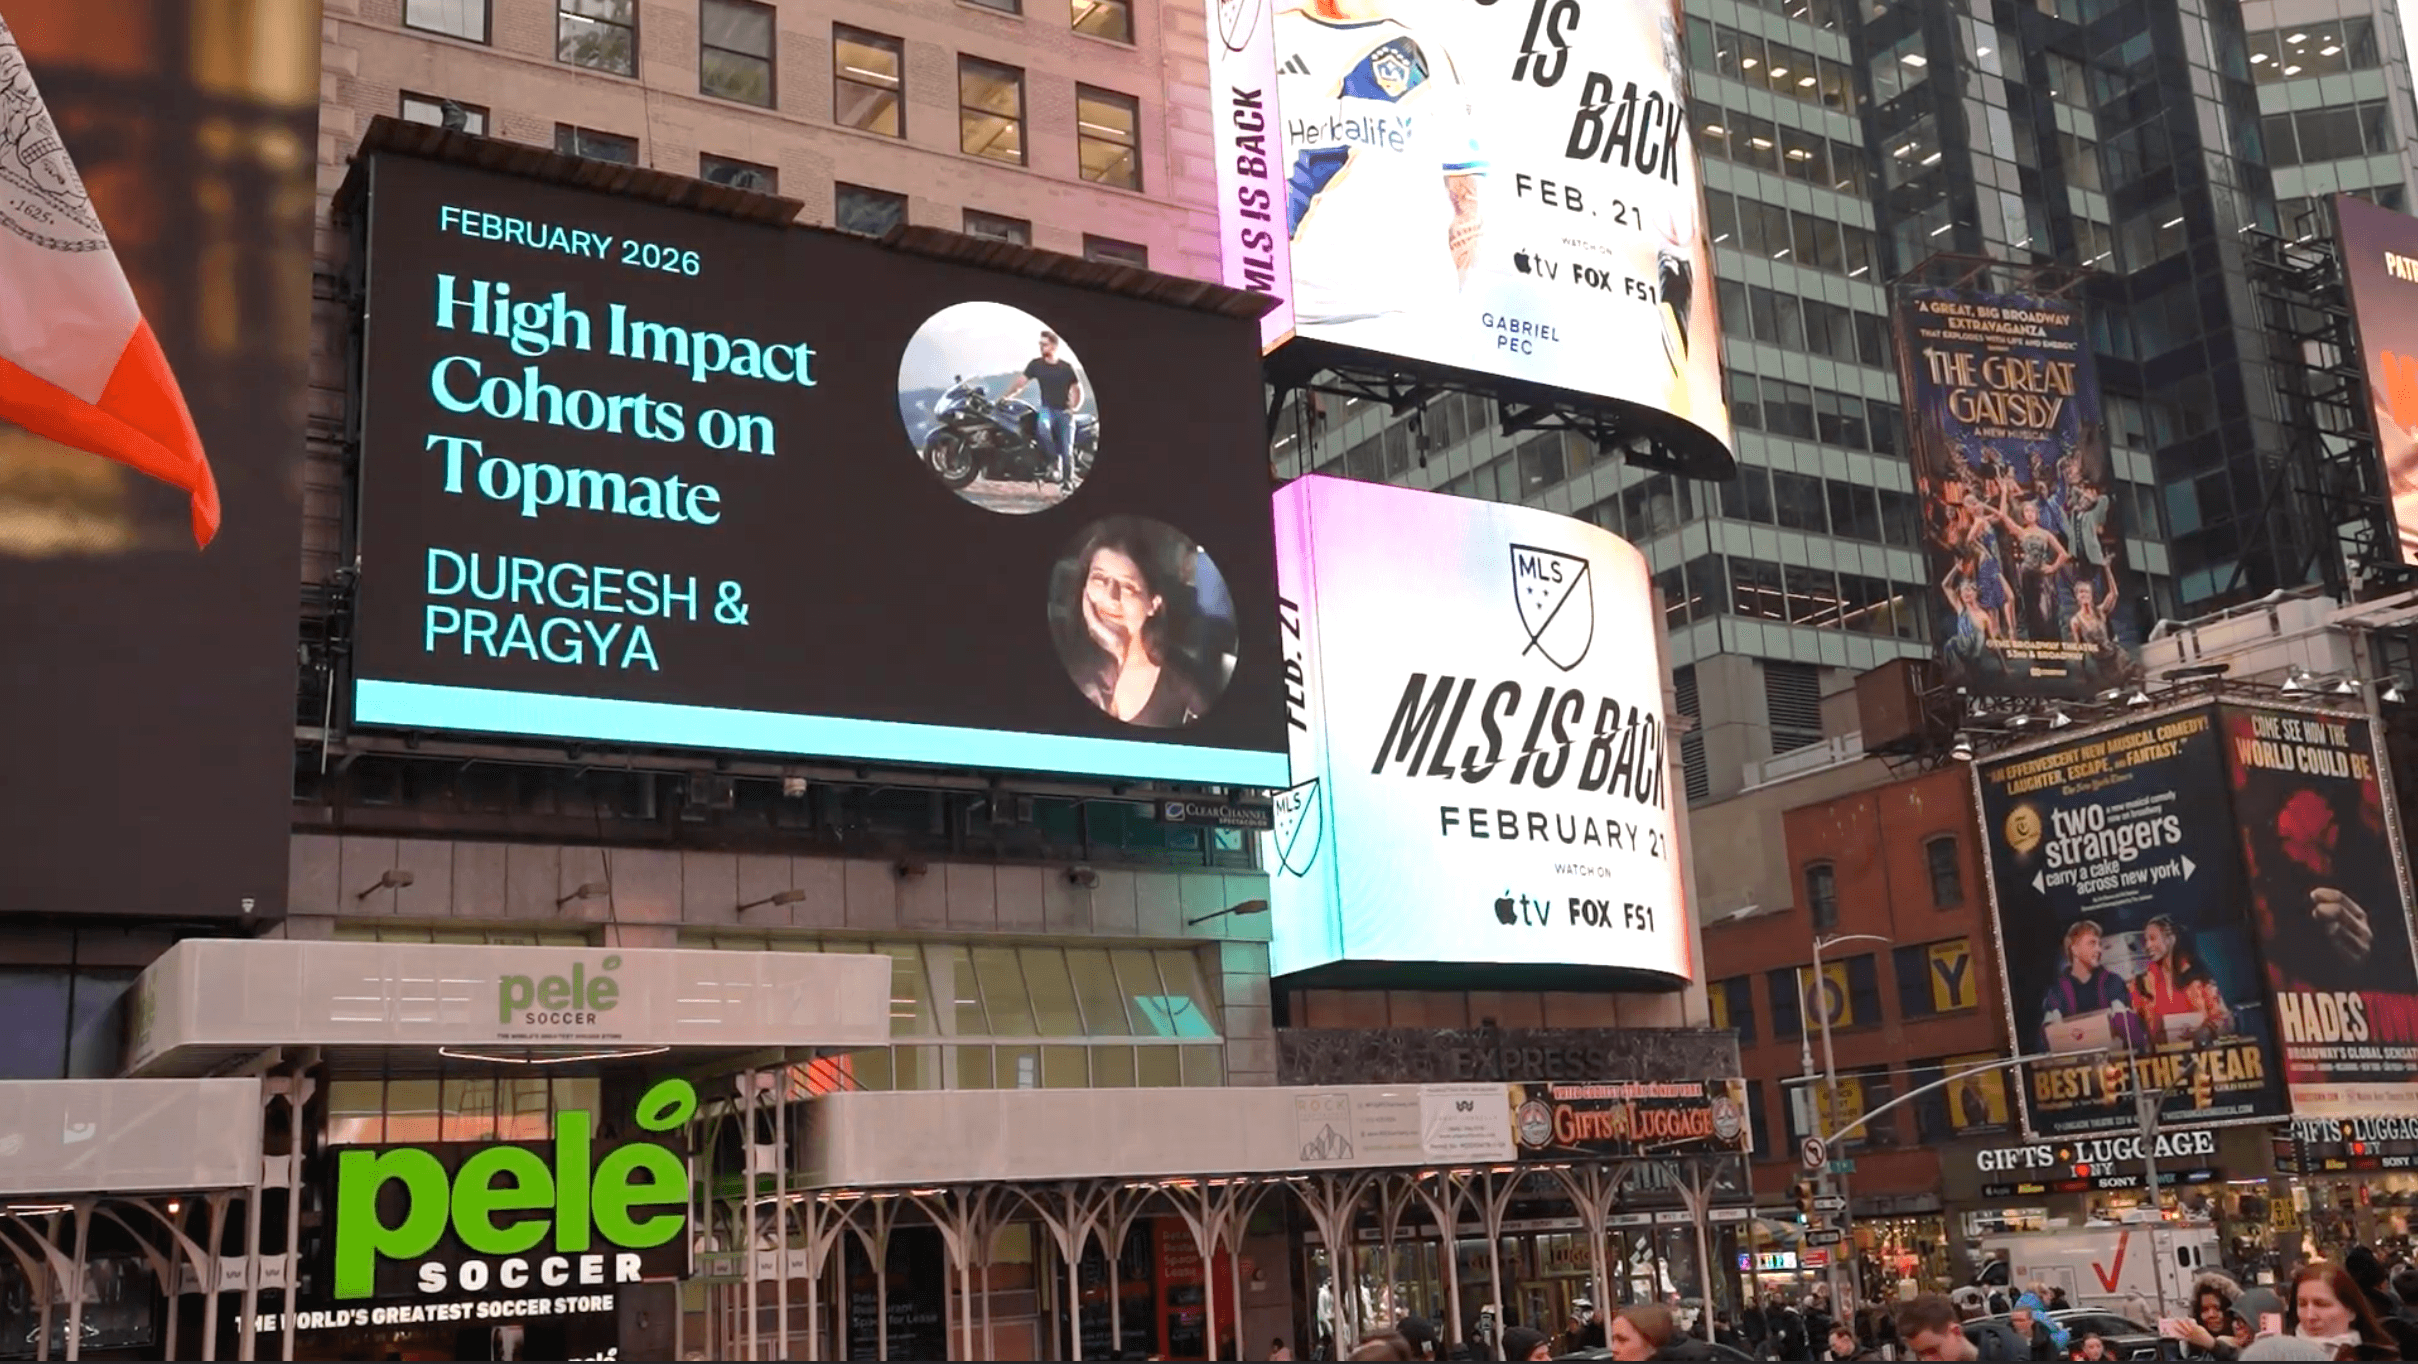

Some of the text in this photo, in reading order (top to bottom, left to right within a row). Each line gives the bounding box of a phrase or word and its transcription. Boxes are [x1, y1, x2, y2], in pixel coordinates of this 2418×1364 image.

[1511, 0, 1580, 87] IS
[1288, 115, 1405, 152] Herbalife
[1565, 71, 1682, 185] BACK
[1231, 86, 1275, 291] MLS IS BACK
[1516, 173, 1642, 231] FEB. 21
[441, 205, 701, 276] FEBRUARY 2026
[1561, 237, 1596, 250] WATCH
[1573, 263, 1612, 292] FOX
[1624, 277, 1657, 305] FS1
[435, 273, 817, 388] High Impact
[1482, 312, 1560, 342] GABRIEL
[1948, 317, 2047, 338] EXTRAVAGANZA
[1977, 306, 2000, 319] BIG
[2001, 308, 2070, 326] BROADWAY
[1497, 335, 1533, 355] PEC
[1922, 346, 2075, 396] THE GREAT
[431, 356, 775, 456] Cohorts on
[1950, 388, 2064, 429] GATSBY
[425, 434, 721, 525] Topmate
[427, 547, 750, 626] DURGESH &
[1519, 554, 1564, 585] MLS
[425, 605, 660, 671] PRAGYA
[1371, 672, 1667, 811] MLS IS BACK
[2106, 727, 2156, 755] MUSICAL
[2251, 715, 2349, 747] COME SEE HOW THE
[2235, 737, 2295, 771] WORLD
[2296, 745, 2349, 778] COULD
[1276, 792, 1302, 816] MLS
[2051, 803, 2105, 839] two
[1440, 806, 1638, 852] FEBRUARY
[2045, 815, 2182, 869] strangers
[1554, 863, 1612, 878] WATCH ON
[2045, 859, 2121, 888] carry a cake
[2076, 858, 2181, 895] across new york
[1569, 897, 1612, 929] FOX
[1624, 902, 1655, 932] FS1
[500, 954, 622, 1025] pelé
[1933, 953, 1970, 1007] Y
[525, 1012, 597, 1025] SOCCER
[1453, 1046, 1606, 1080] EXPRESS
[2034, 1065, 2092, 1101] BEST
[2131, 1052, 2190, 1090] THE
[2190, 1046, 2264, 1082] YEAR
[1554, 1103, 1613, 1144] GIFTS
[1626, 1101, 1714, 1141] LUGGAGE
[2289, 1119, 2343, 1143] GIFTS
[1976, 1145, 2054, 1172] GIFTS
[2382, 1157, 2411, 1168] SONY
[334, 1078, 697, 1299] pelé
[2098, 1176, 2137, 1188] SONY
[418, 1253, 642, 1293] SOCCER
[372, 1301, 472, 1324] GREATEST
[476, 1297, 552, 1318] SOCCER
[555, 1294, 614, 1313] STORE
